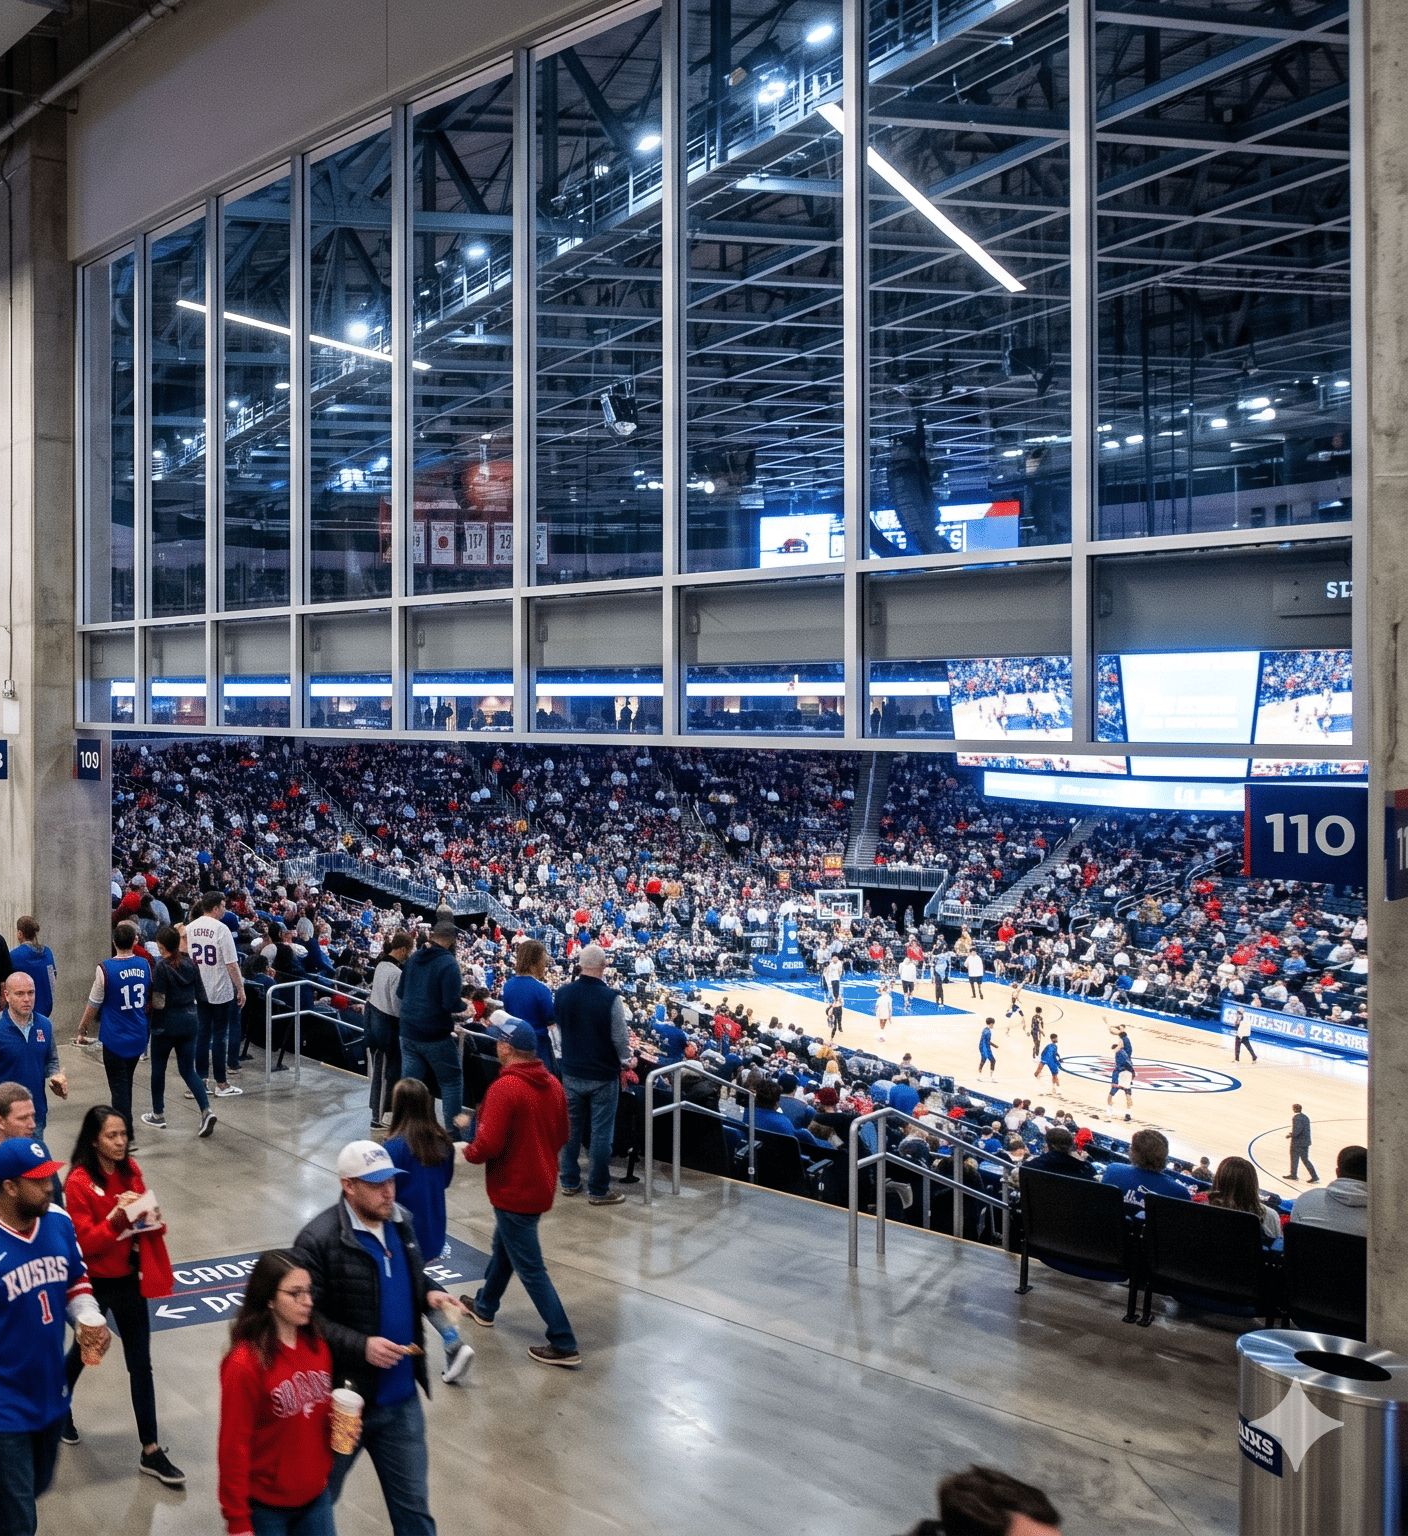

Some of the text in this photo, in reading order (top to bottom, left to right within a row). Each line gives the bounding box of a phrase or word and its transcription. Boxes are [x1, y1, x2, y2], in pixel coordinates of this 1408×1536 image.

[80, 751, 99, 769] 109
[1264, 813, 1356, 857] 110
[191, 943, 217, 966] 28
[120, 983, 145, 1010] 13
[37, 1290, 53, 1325] 1
